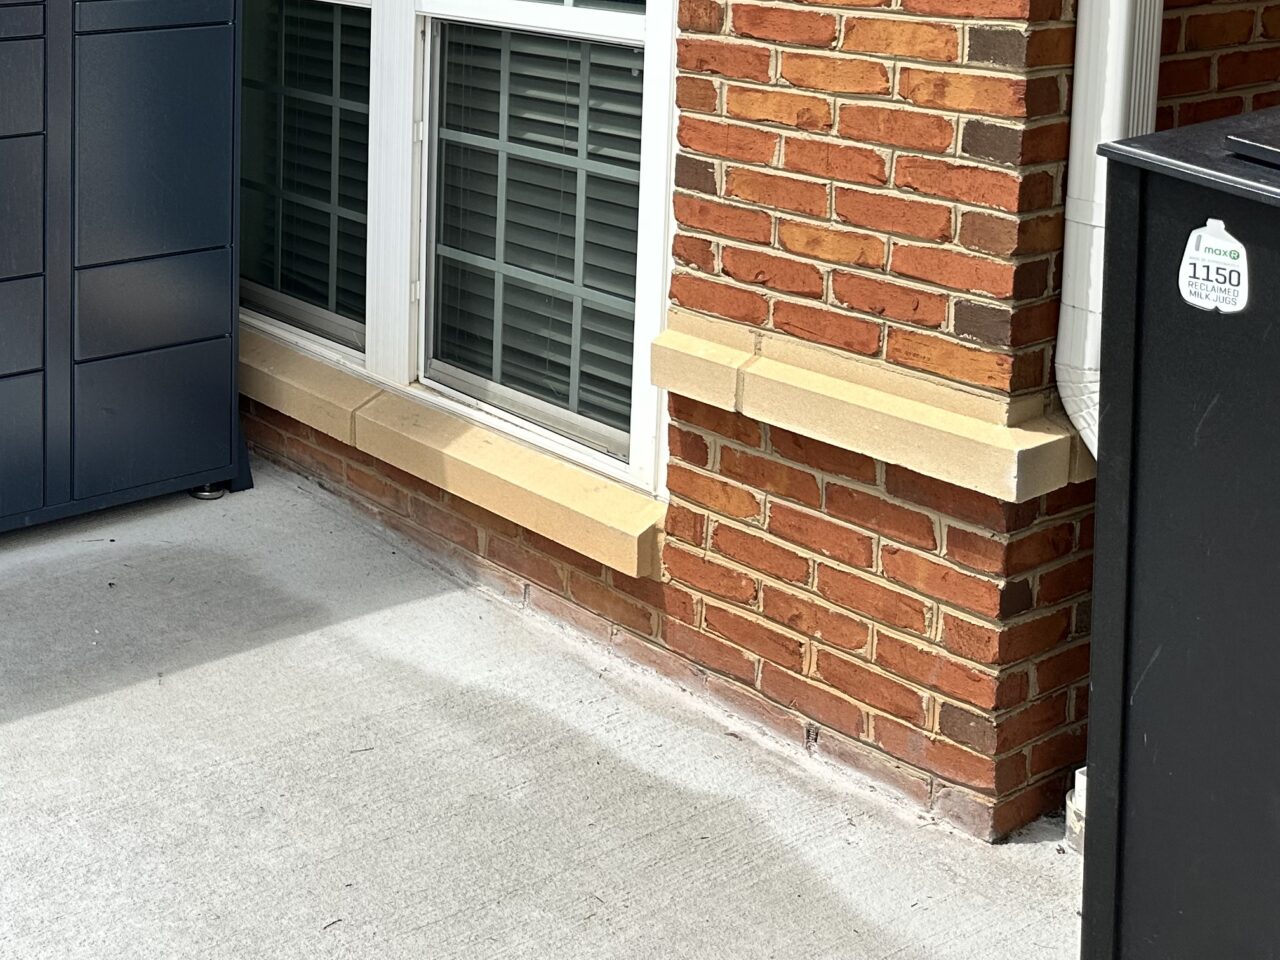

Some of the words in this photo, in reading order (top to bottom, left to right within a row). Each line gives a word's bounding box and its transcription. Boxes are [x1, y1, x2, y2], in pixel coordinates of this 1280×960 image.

[1188, 262, 1241, 287] 1150
[1187, 280, 1240, 298] RECLAIMED
[1189, 289, 1211, 301] MILK
[1212, 296, 1237, 306] JUGS
